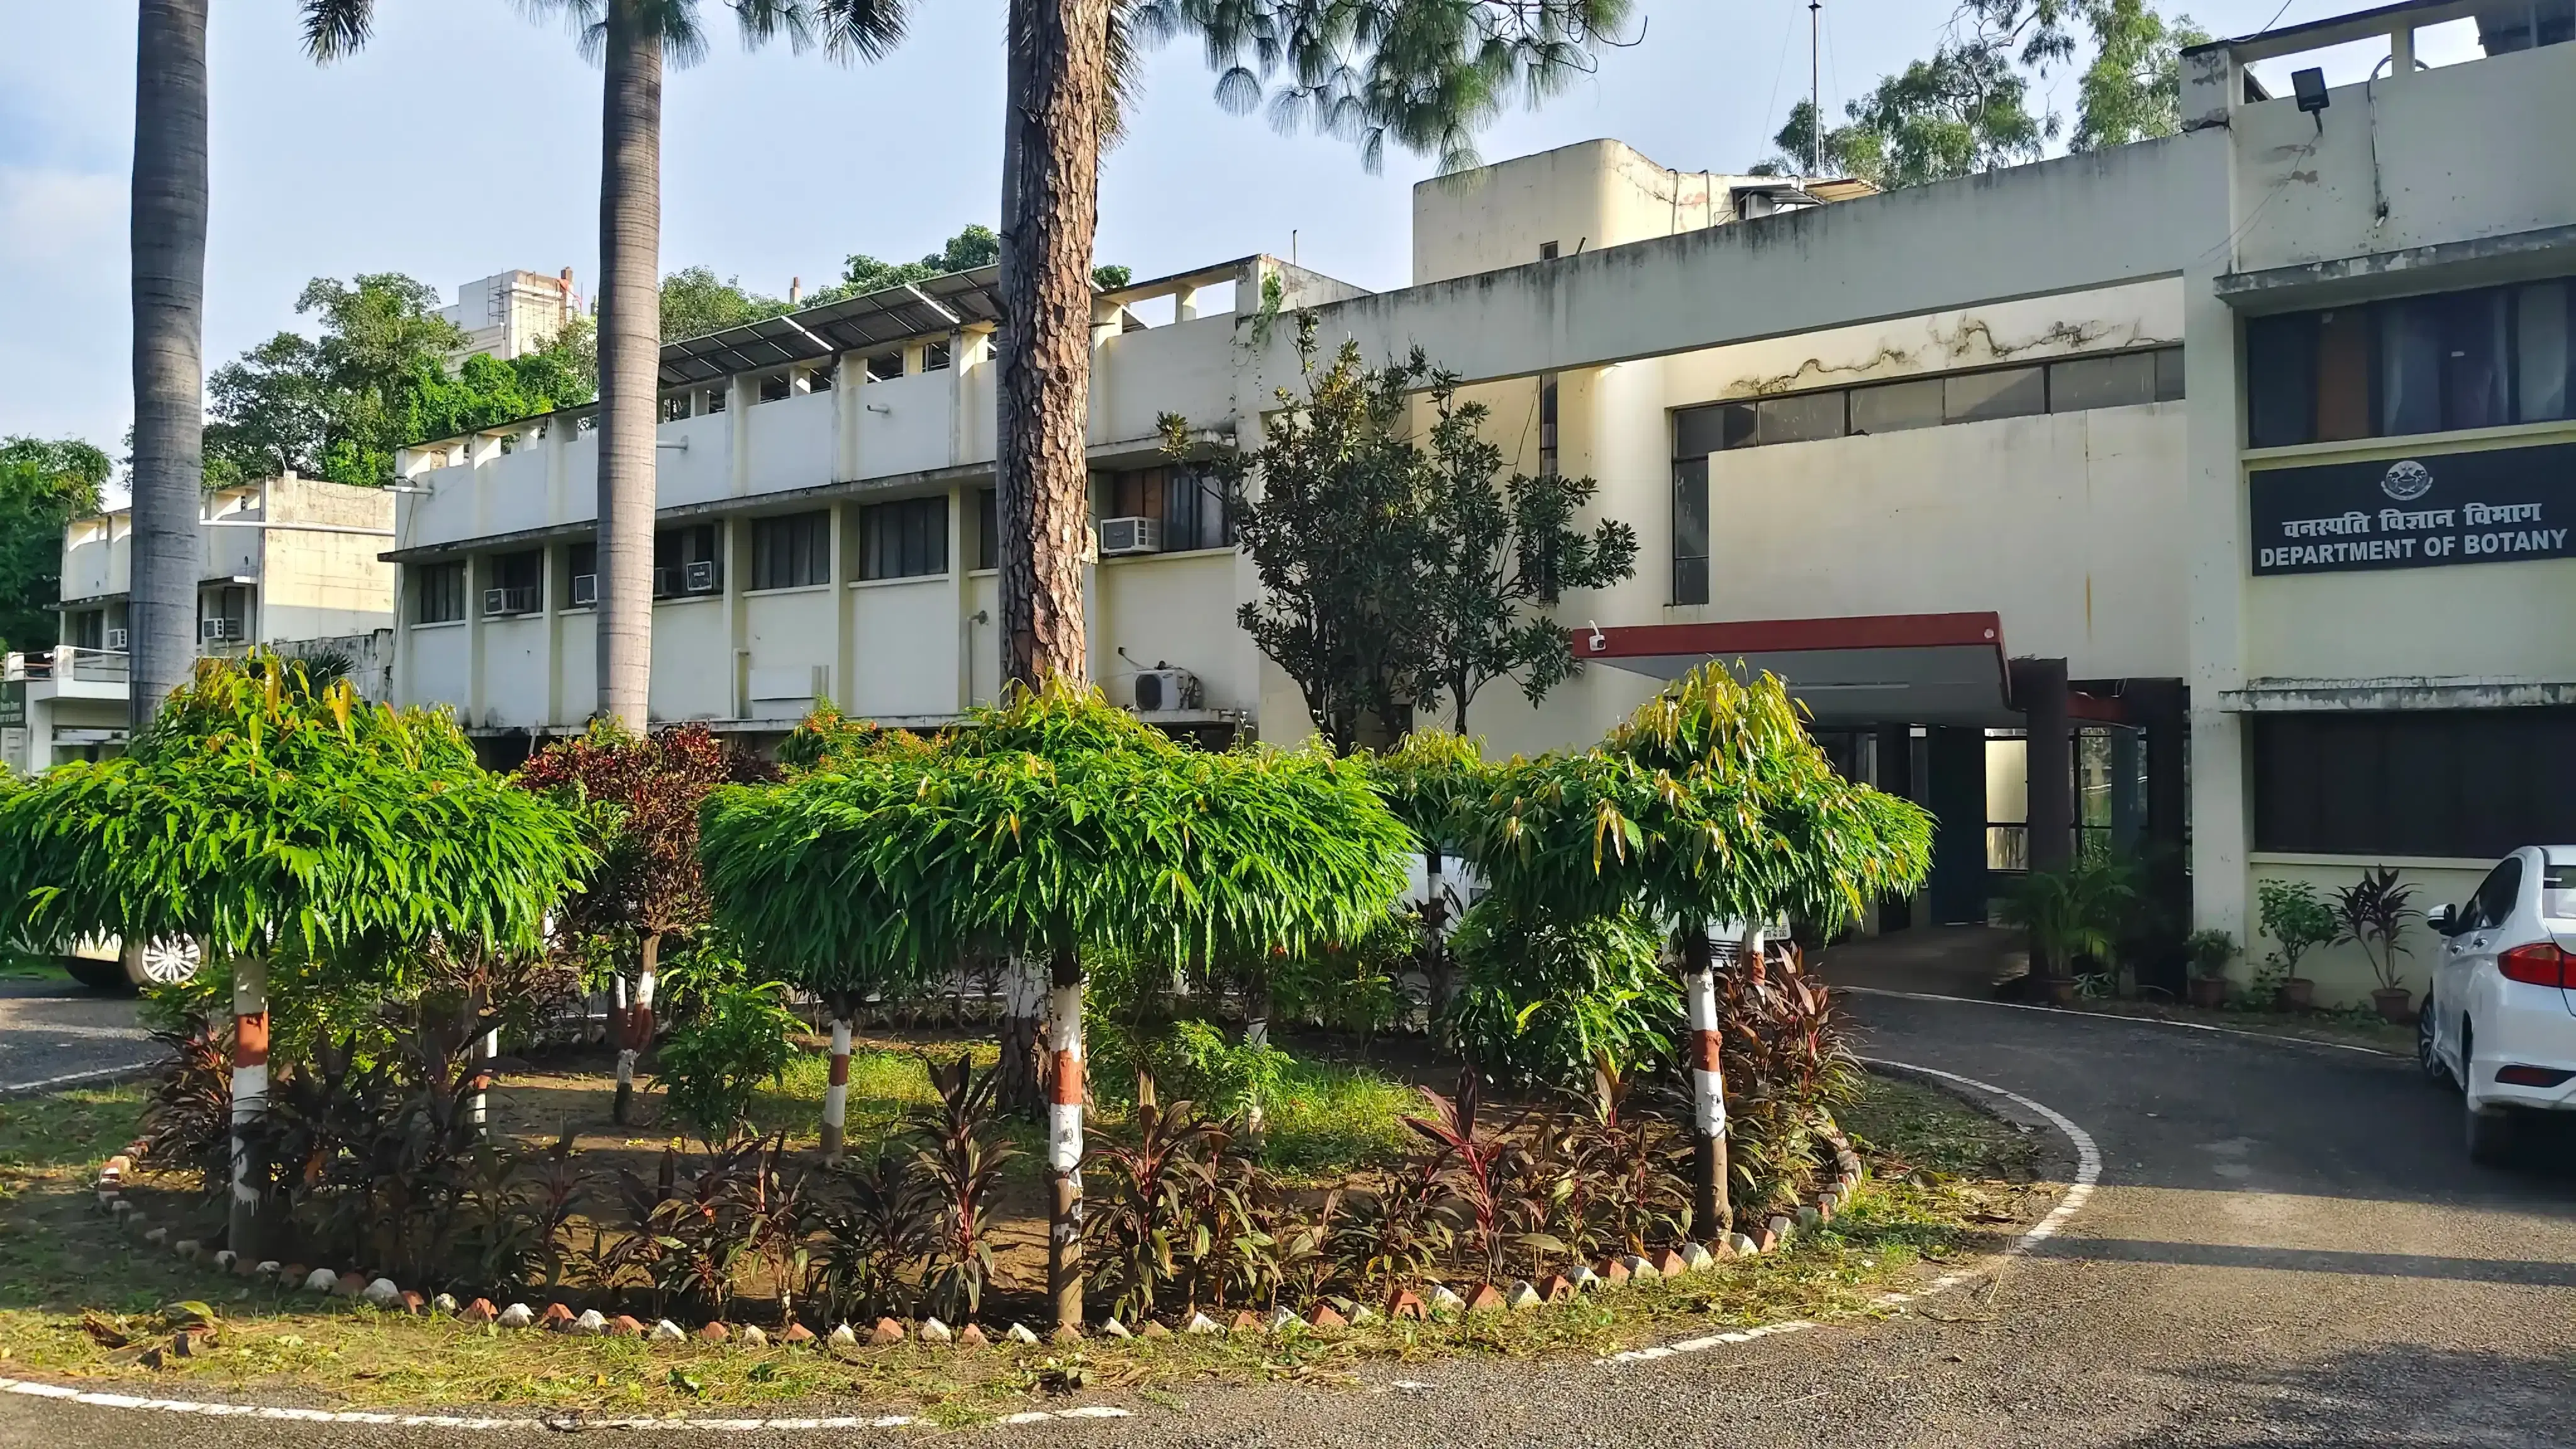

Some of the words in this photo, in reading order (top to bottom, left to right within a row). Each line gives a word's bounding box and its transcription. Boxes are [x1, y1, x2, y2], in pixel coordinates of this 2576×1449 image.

[2282, 511, 2371, 538] वनस्पति
[2379, 508, 2455, 531] विज्ञान
[2463, 502, 2542, 526] विभाग
[2260, 538, 2416, 567] DEPARTMENT
[2424, 536, 2455, 557] OF
[2465, 528, 2568, 555] BOTANY
